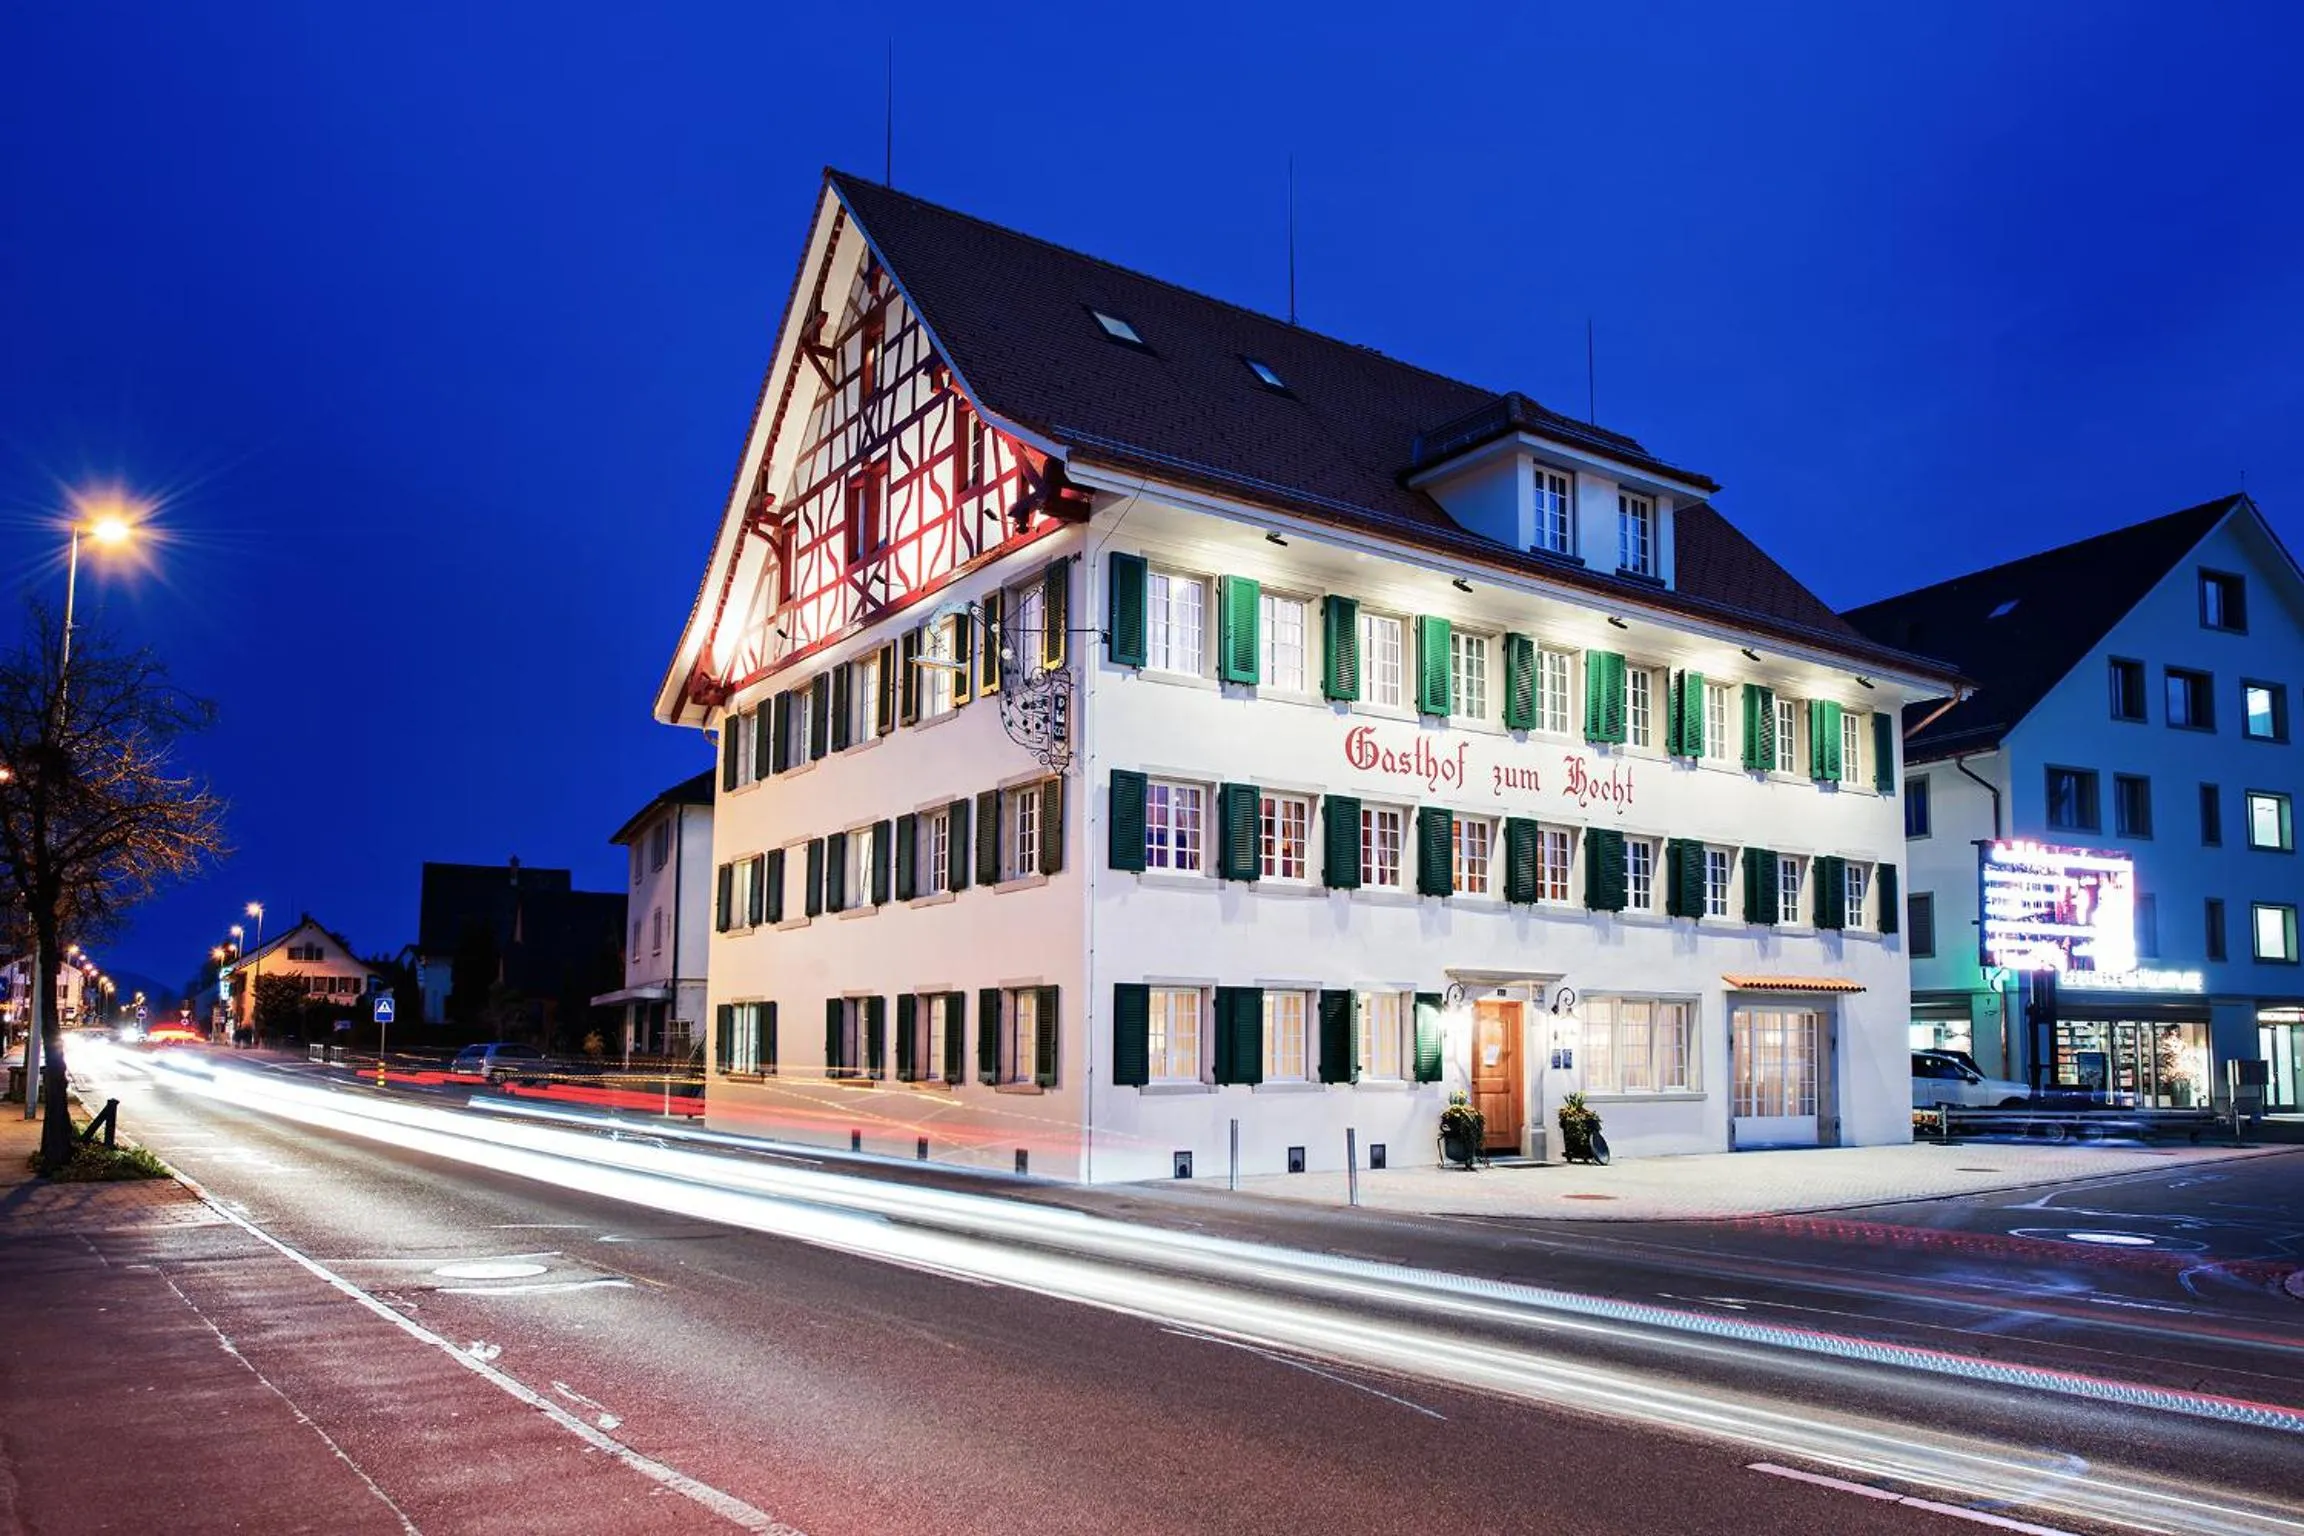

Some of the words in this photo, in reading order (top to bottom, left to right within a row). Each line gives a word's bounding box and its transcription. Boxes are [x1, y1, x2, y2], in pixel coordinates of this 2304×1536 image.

[1345, 726, 1469, 792] Gasthof
[1492, 764, 1541, 796] zum
[1563, 755, 1635, 815] Hecht
